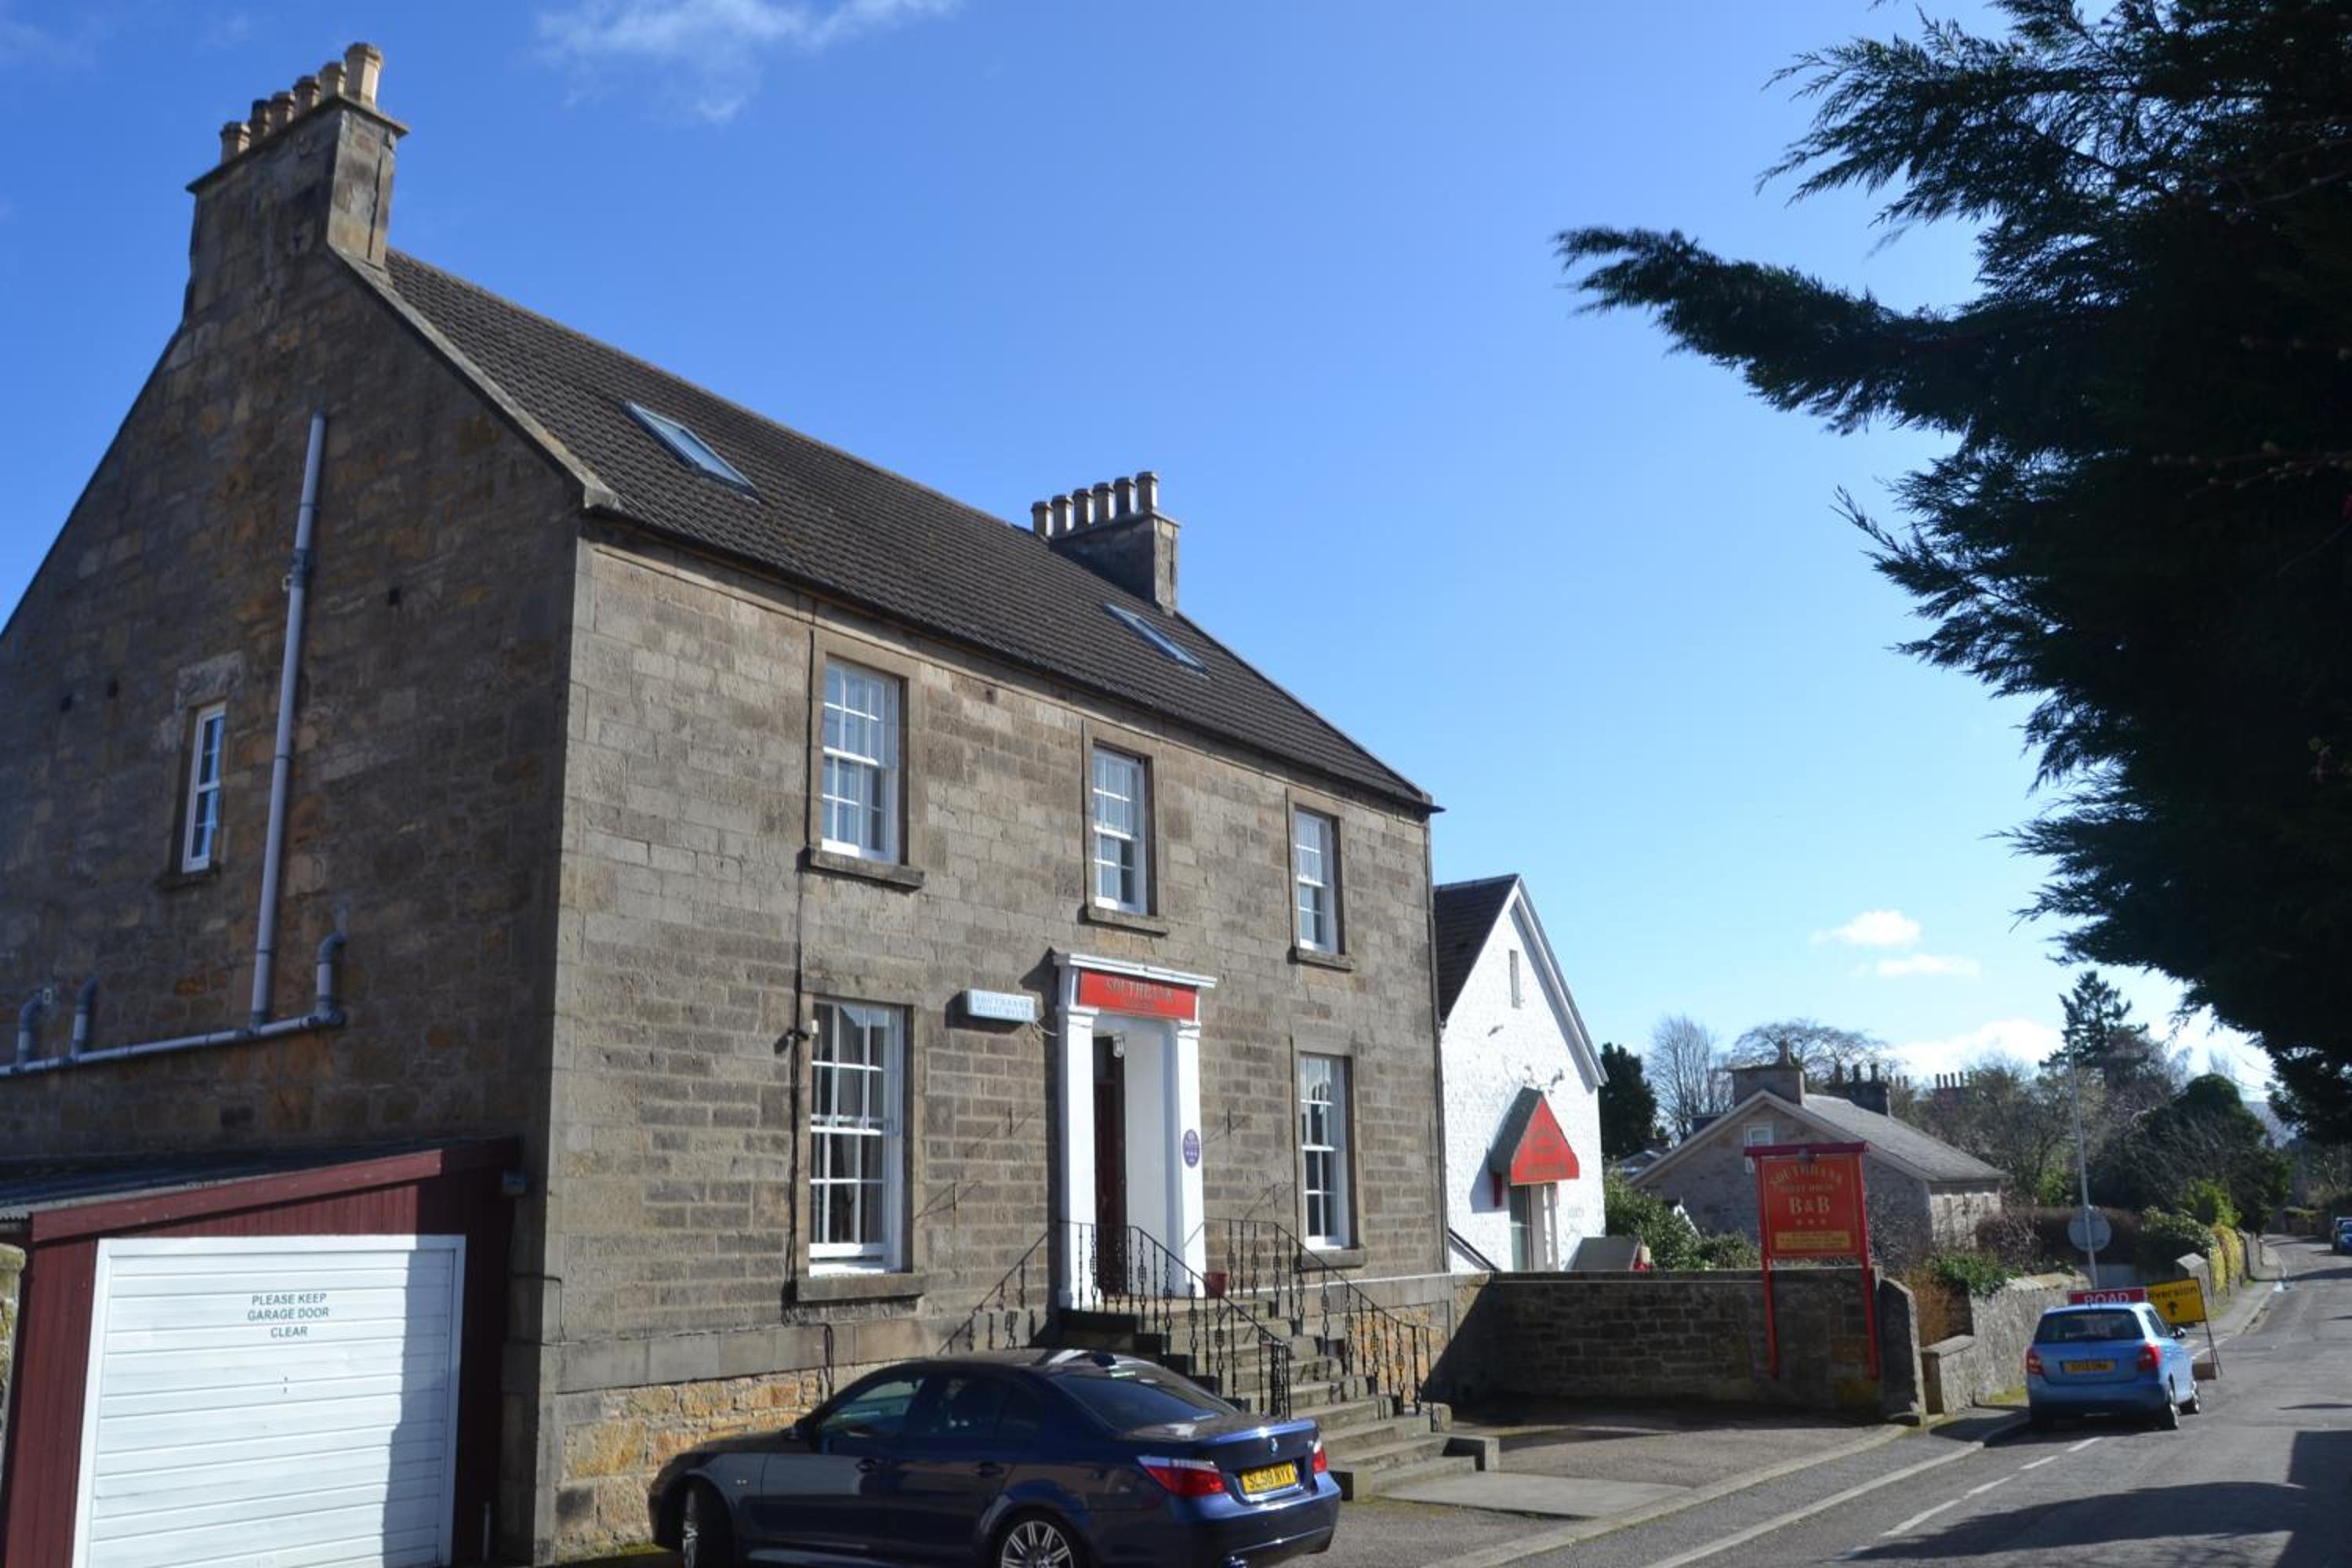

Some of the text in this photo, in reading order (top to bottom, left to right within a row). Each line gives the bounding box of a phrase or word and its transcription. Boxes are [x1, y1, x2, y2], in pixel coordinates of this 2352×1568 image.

[1788, 1196, 1831, 1215] B&B
[252, 1292, 327, 1305] PLEASE KEEP
[2084, 1292, 2129, 1304] ROAD
[247, 1306, 329, 1320] GARAGE DOOR
[270, 1326, 308, 1338] CLEAR
